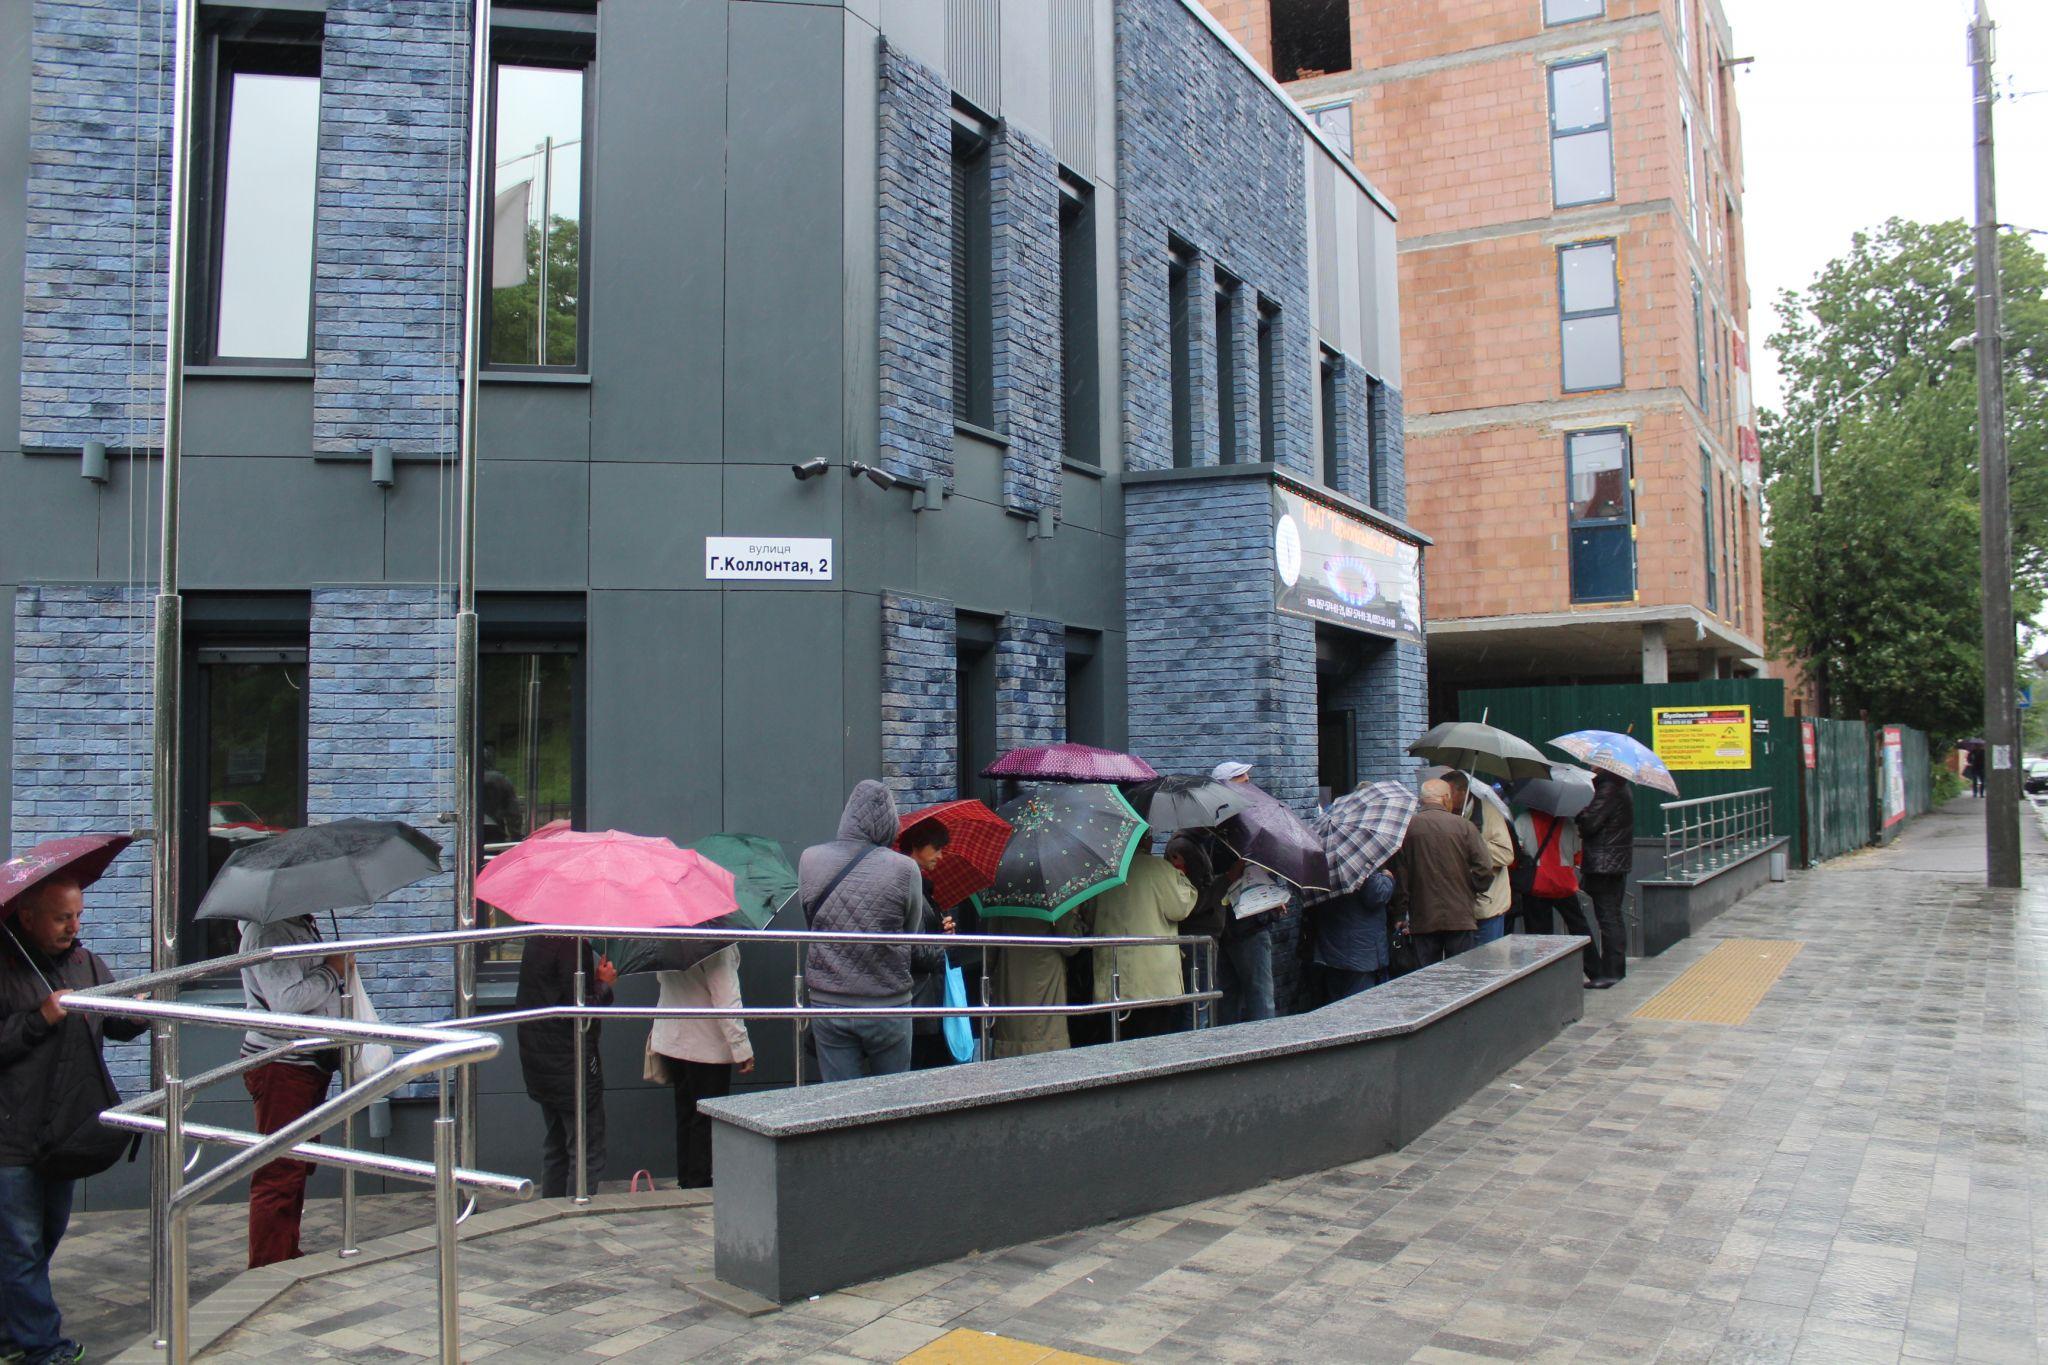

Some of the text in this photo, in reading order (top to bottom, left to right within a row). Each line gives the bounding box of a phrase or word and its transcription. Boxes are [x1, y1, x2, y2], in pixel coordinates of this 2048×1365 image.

[749, 544, 791, 555] вулиця
[710, 556, 828, 575] Г.Коллонтая, 2
